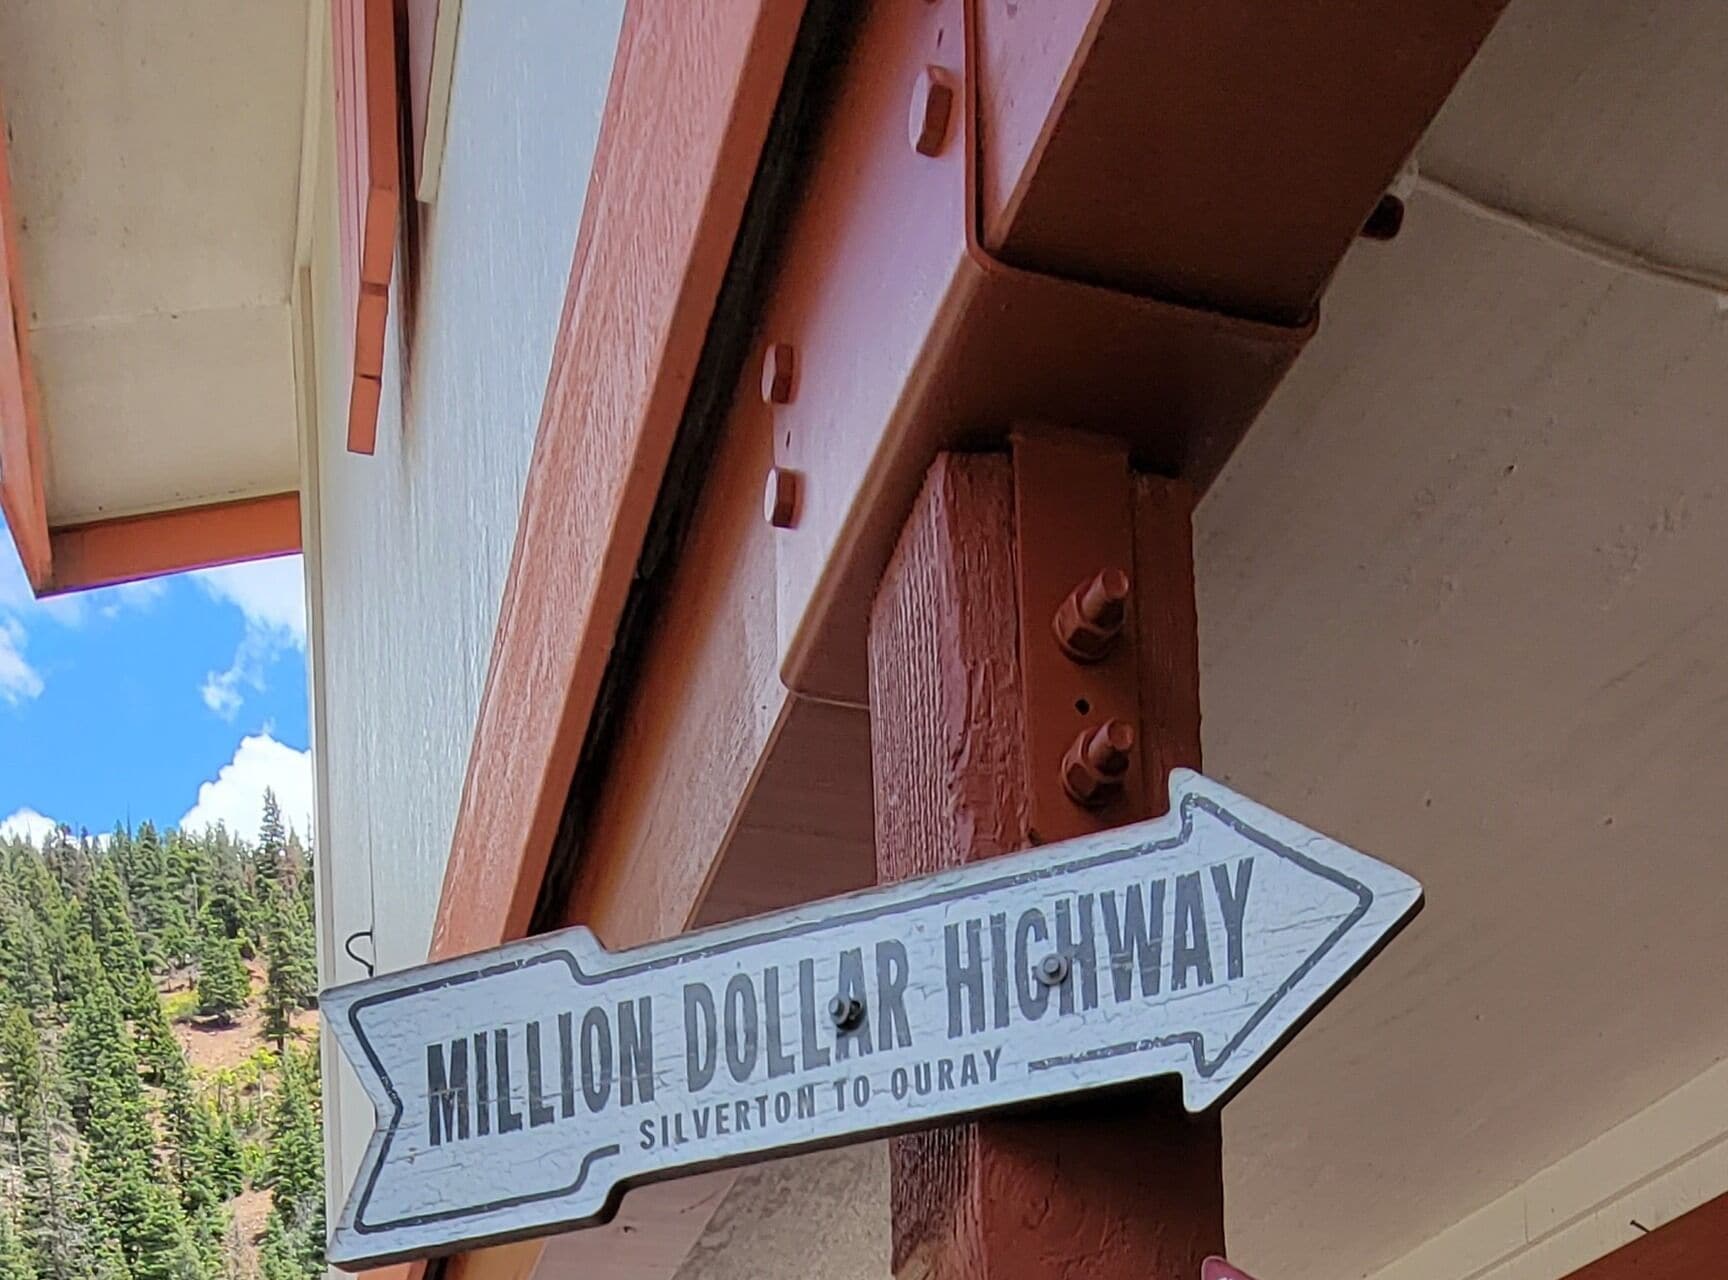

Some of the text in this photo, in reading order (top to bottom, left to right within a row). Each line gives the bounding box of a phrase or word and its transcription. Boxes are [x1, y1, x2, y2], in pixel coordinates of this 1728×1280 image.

[427, 857, 1257, 1147] MILLION DOLLAR HIGHWAY
[638, 1049, 1005, 1152] SILVERTON TO OURAY
